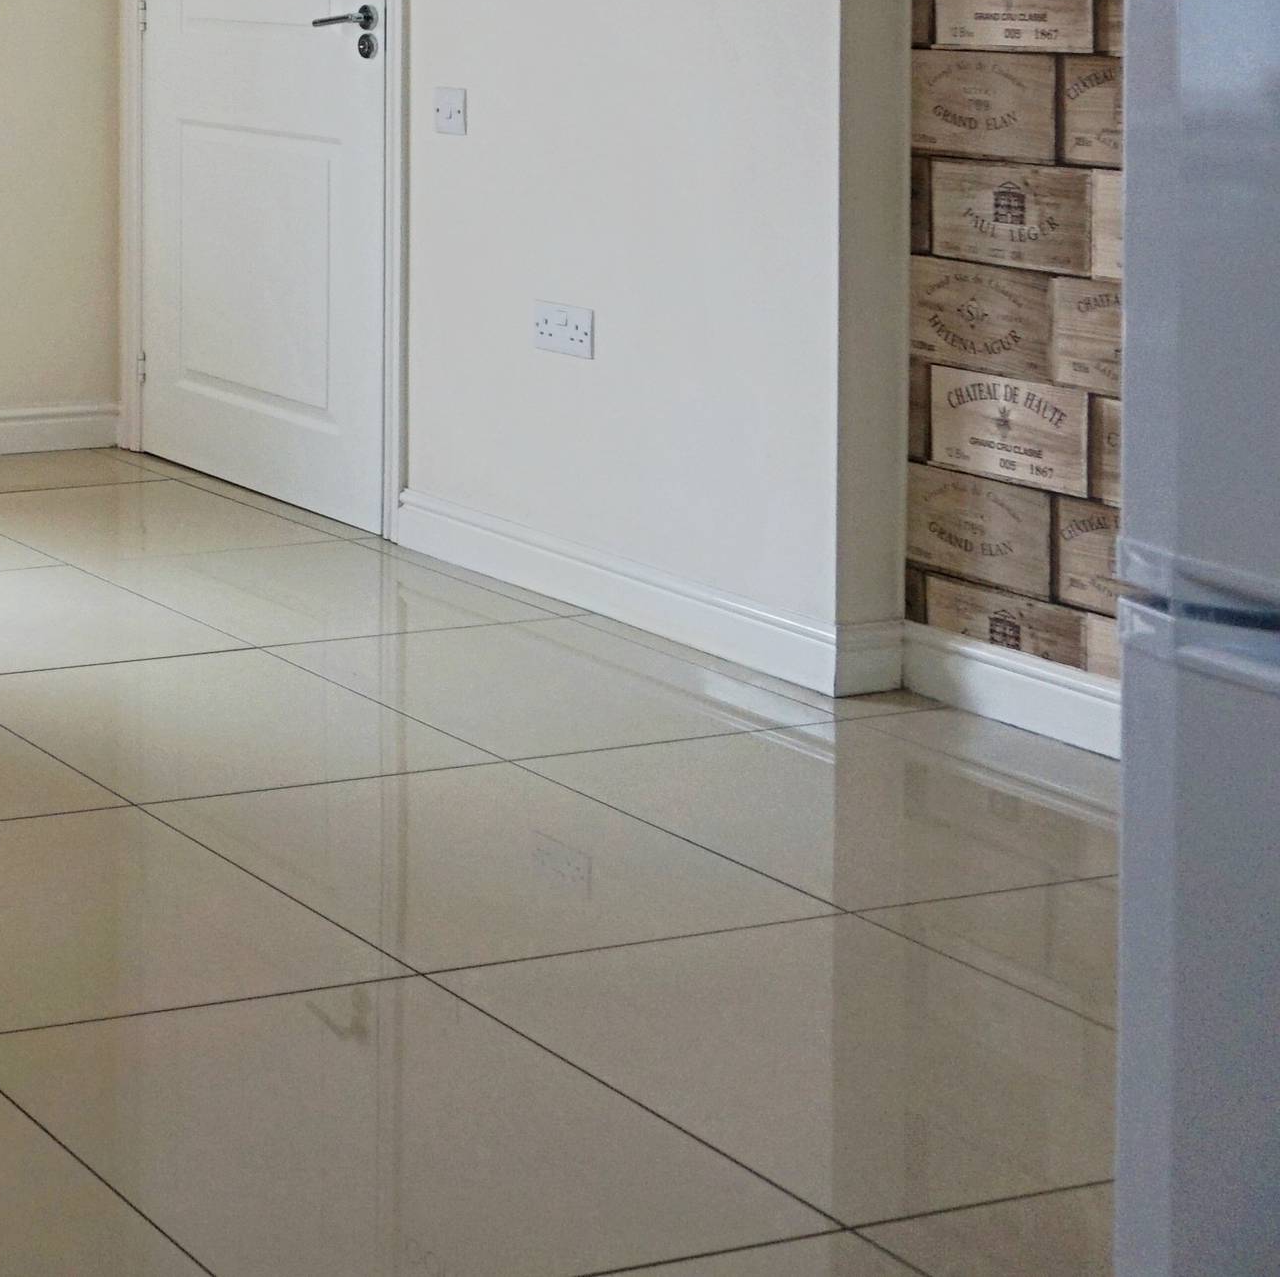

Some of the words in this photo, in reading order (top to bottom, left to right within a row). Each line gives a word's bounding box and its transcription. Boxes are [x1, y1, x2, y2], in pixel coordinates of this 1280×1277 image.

[932, 104, 978, 130] GRAND
[985, 110, 1019, 131] ELAN
[1004, 383, 1020, 404] DE
[1024, 391, 1068, 429] HAUTE
[1030, 463, 1054, 479] 1867
[928, 521, 973, 552] GRAND
[980, 541, 1014, 557] ELAN
